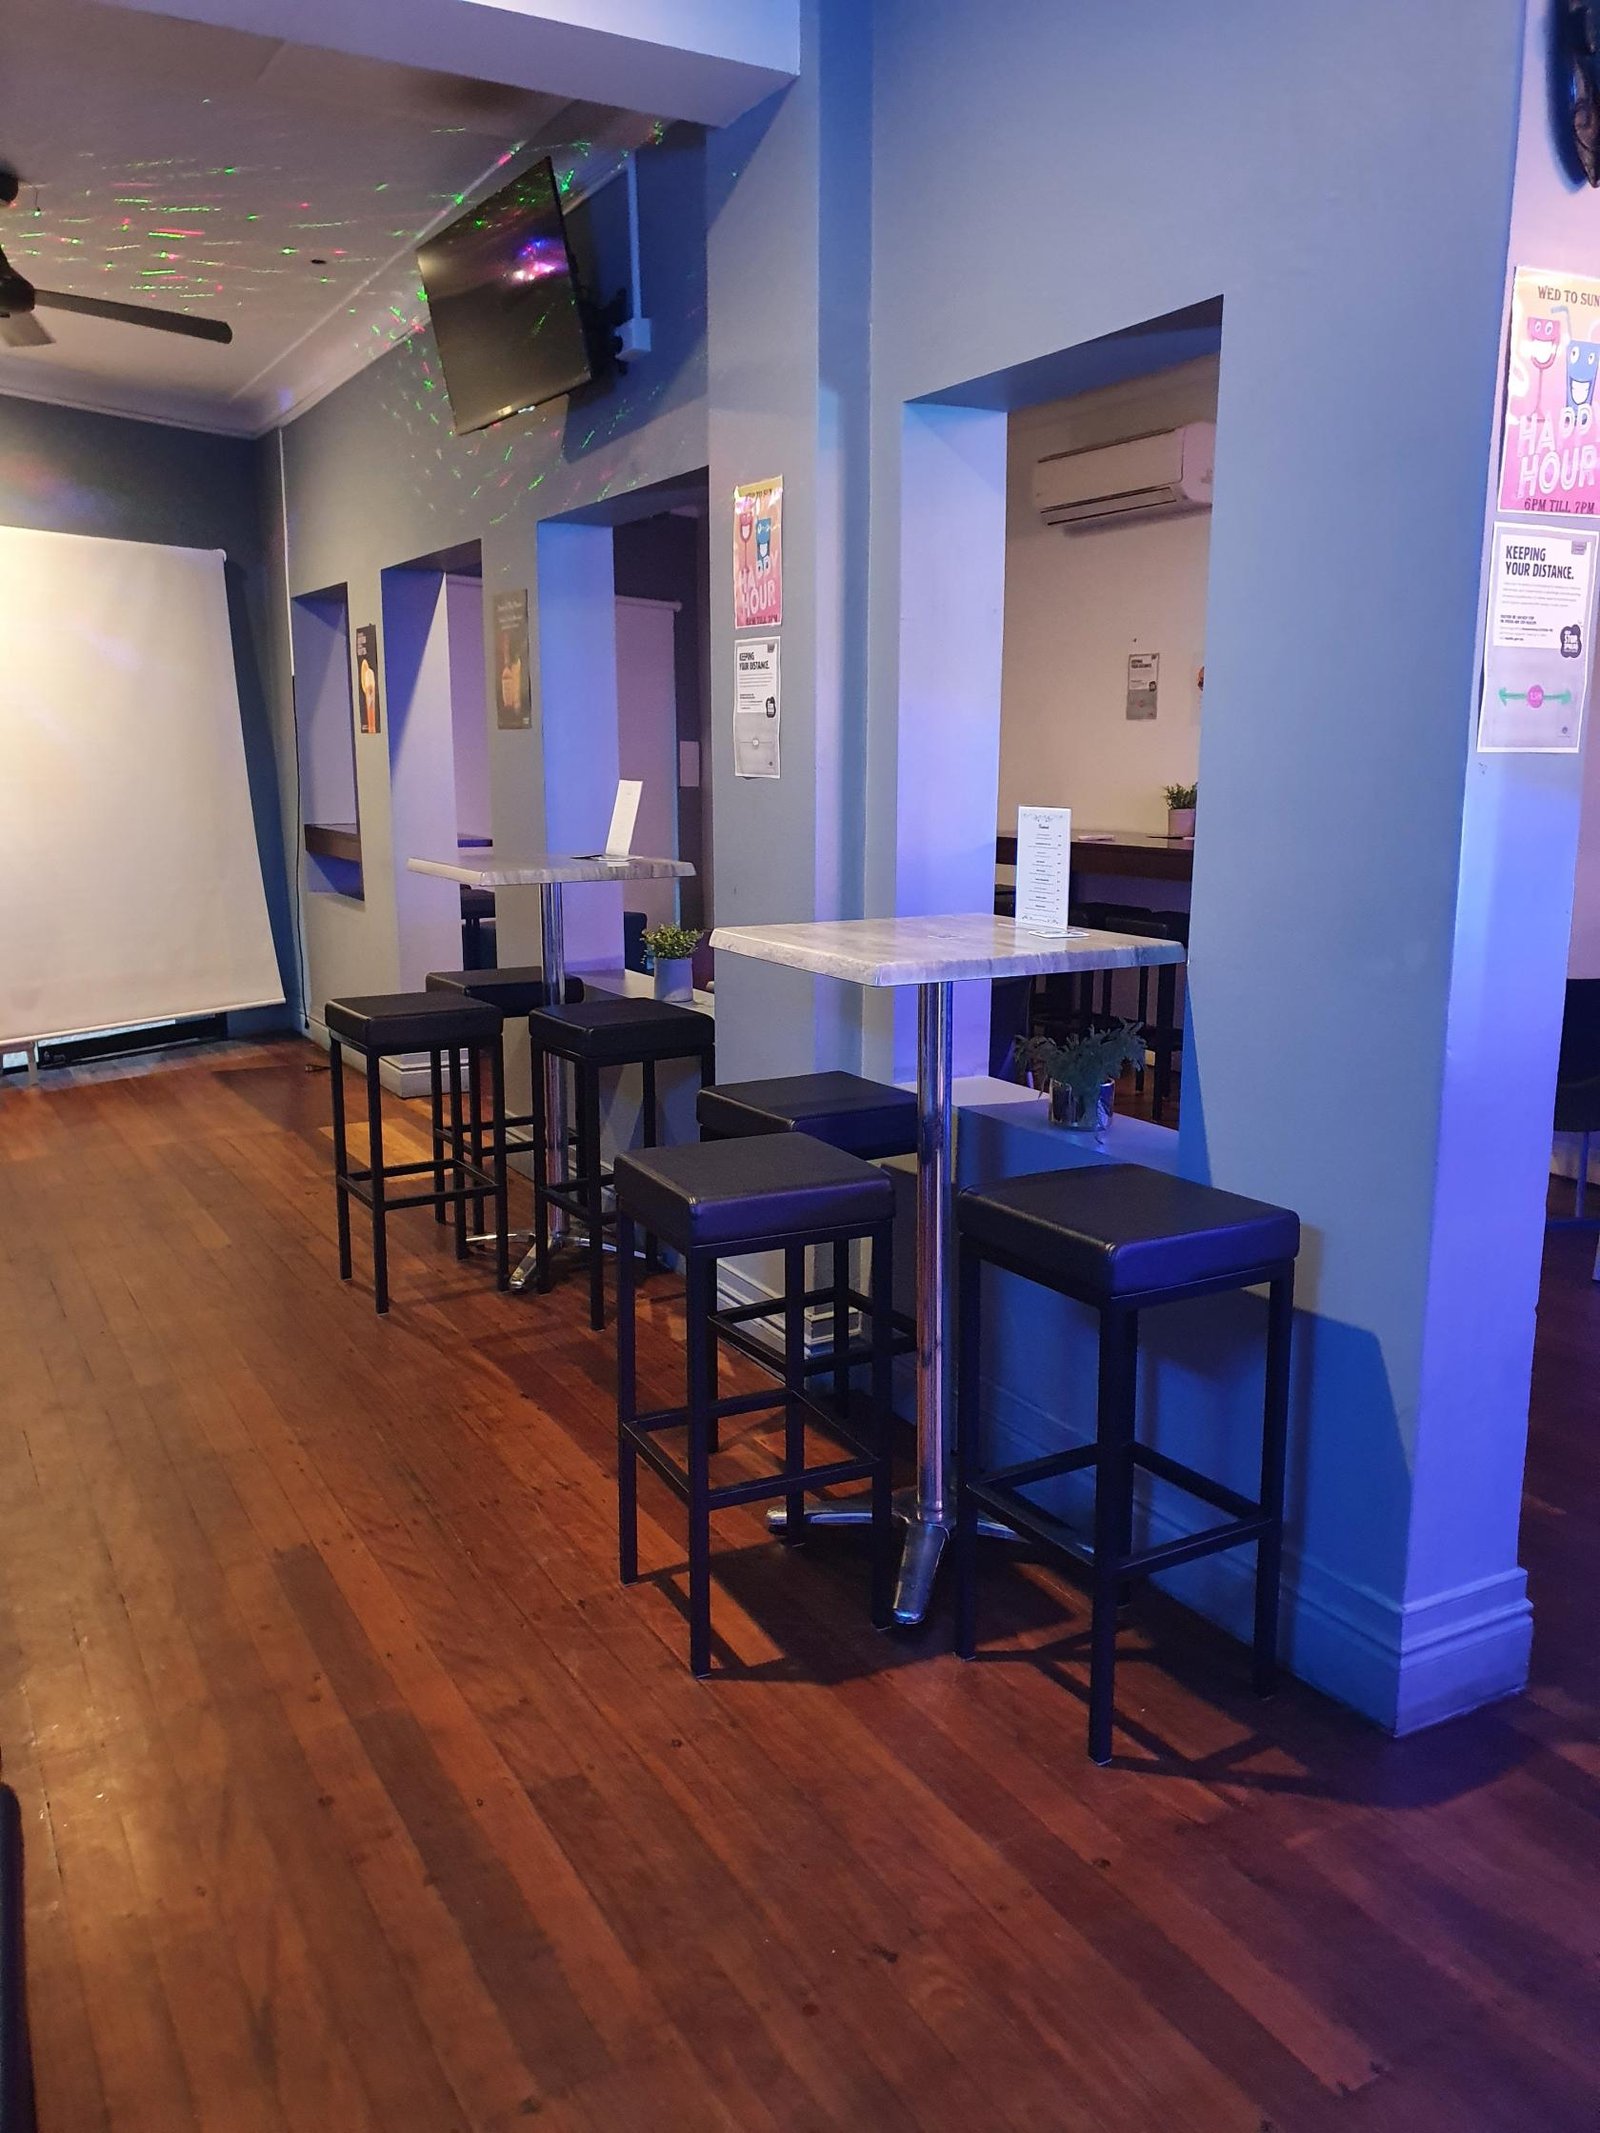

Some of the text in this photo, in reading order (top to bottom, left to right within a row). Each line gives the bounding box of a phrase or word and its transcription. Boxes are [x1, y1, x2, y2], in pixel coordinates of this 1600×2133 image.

[1538, 285, 1600, 307] WED TO SUN
[1516, 444, 1597, 498] HOUR
[1524, 498, 1595, 514] 6PM TILL 7PM
[1505, 545, 1546, 561] KEEPING
[1505, 561, 1574, 580] YOUR DISTANCE.
[741, 580, 776, 618] HOUR
[739, 652, 755, 661] KEEPING
[739, 662, 749, 670] YOUR
